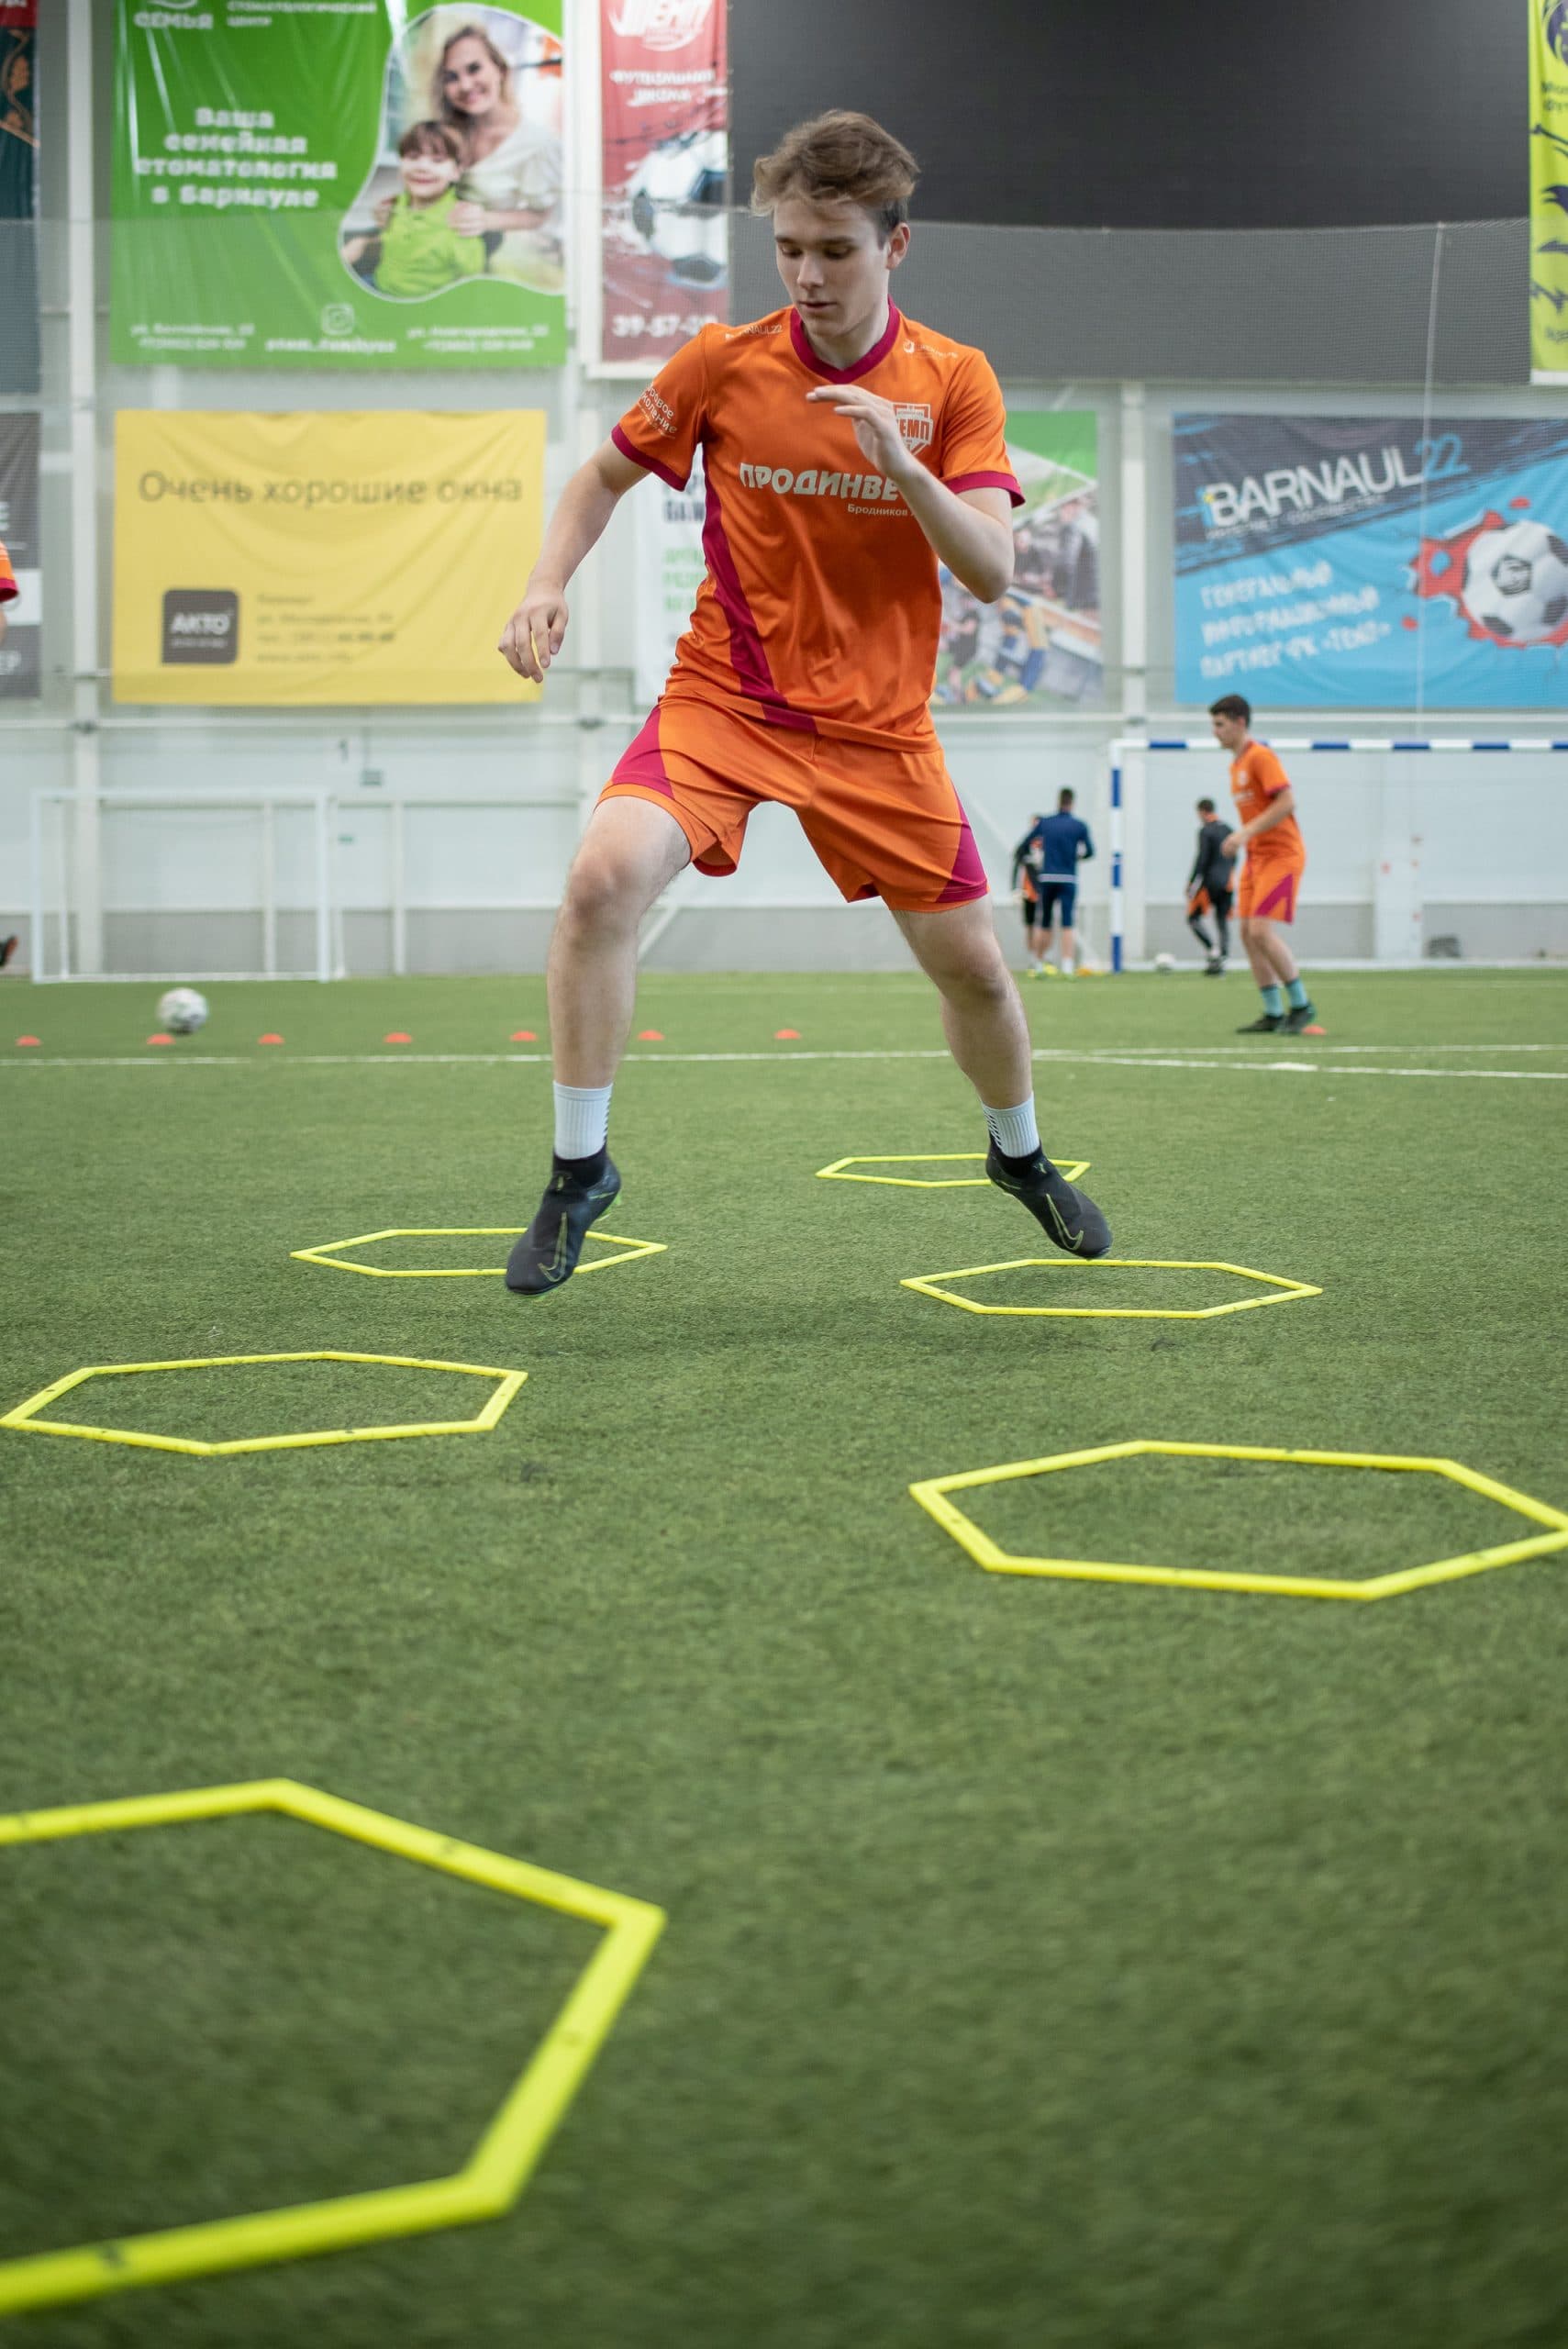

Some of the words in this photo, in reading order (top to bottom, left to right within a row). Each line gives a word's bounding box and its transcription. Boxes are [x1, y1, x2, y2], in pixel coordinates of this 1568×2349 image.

[195, 106, 275, 129] Ваша
[163, 130, 308, 154] семейная
[135, 158, 338, 180] стоматология
[897, 417, 930, 441] ЕМП
[138, 469, 253, 504] Очень
[261, 476, 428, 510] хорошие
[436, 475, 524, 505] окна
[740, 462, 900, 502] ПРОДИНВЕ
[847, 503, 908, 518] Бродников
